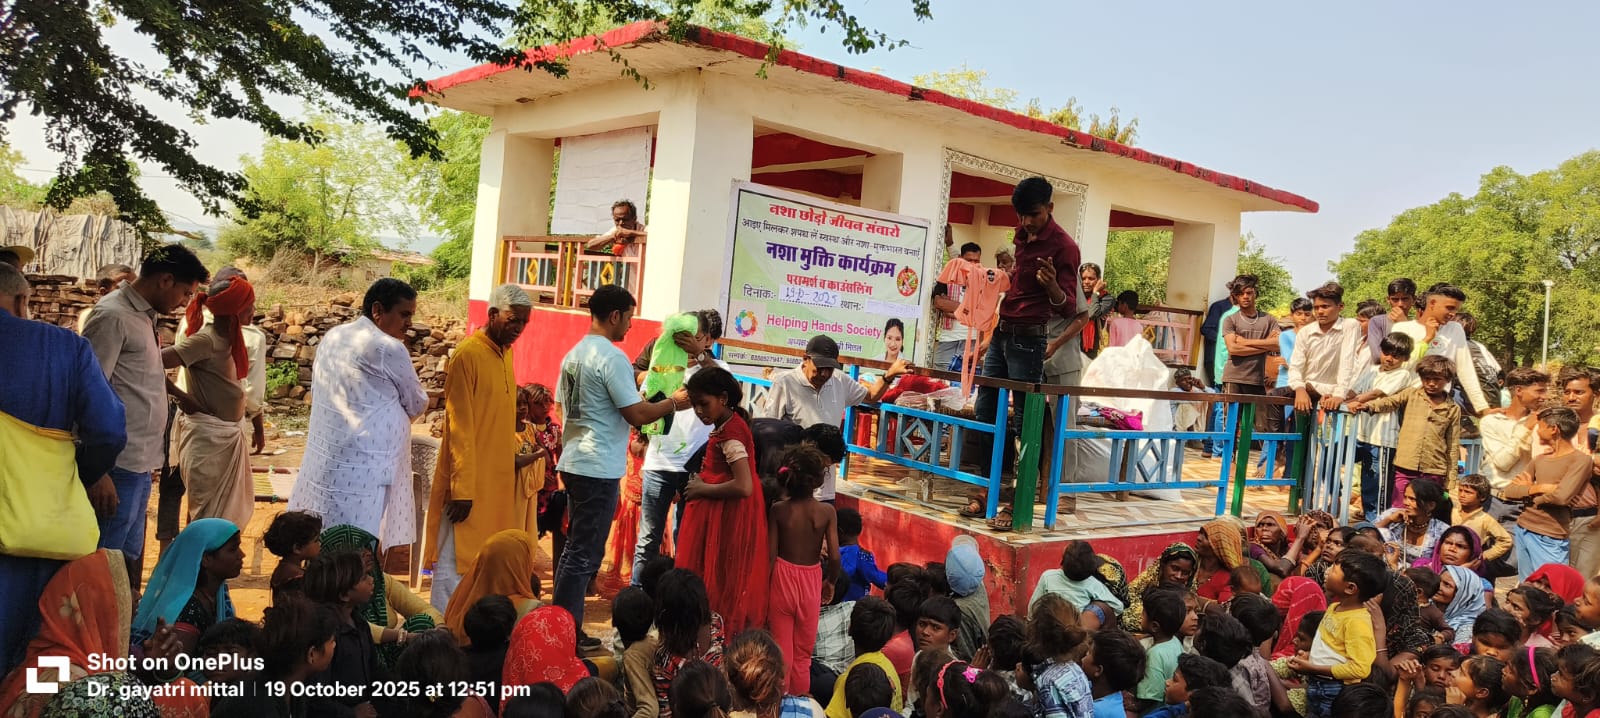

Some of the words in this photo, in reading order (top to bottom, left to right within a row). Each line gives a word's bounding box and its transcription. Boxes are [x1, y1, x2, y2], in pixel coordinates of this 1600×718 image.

[742, 218, 762, 232] आइए
[763, 220, 789, 233] मिलकर
[790, 228, 809, 238] शपथ
[769, 204, 797, 219] नशा
[799, 208, 827, 226] छोड़ो
[829, 215, 864, 232] जीवन
[866, 221, 900, 237] संवारो
[766, 242, 798, 262] नशा
[800, 246, 836, 271] मुक्ति
[838, 254, 897, 277] कार्यक्रम
[787, 274, 818, 288] परामर्श
[819, 279, 826, 289] व
[827, 280, 873, 295] काउंसलिंग
[766, 314, 809, 331] Helping
[811, 320, 843, 333] Hands
[846, 323, 882, 339] Society
